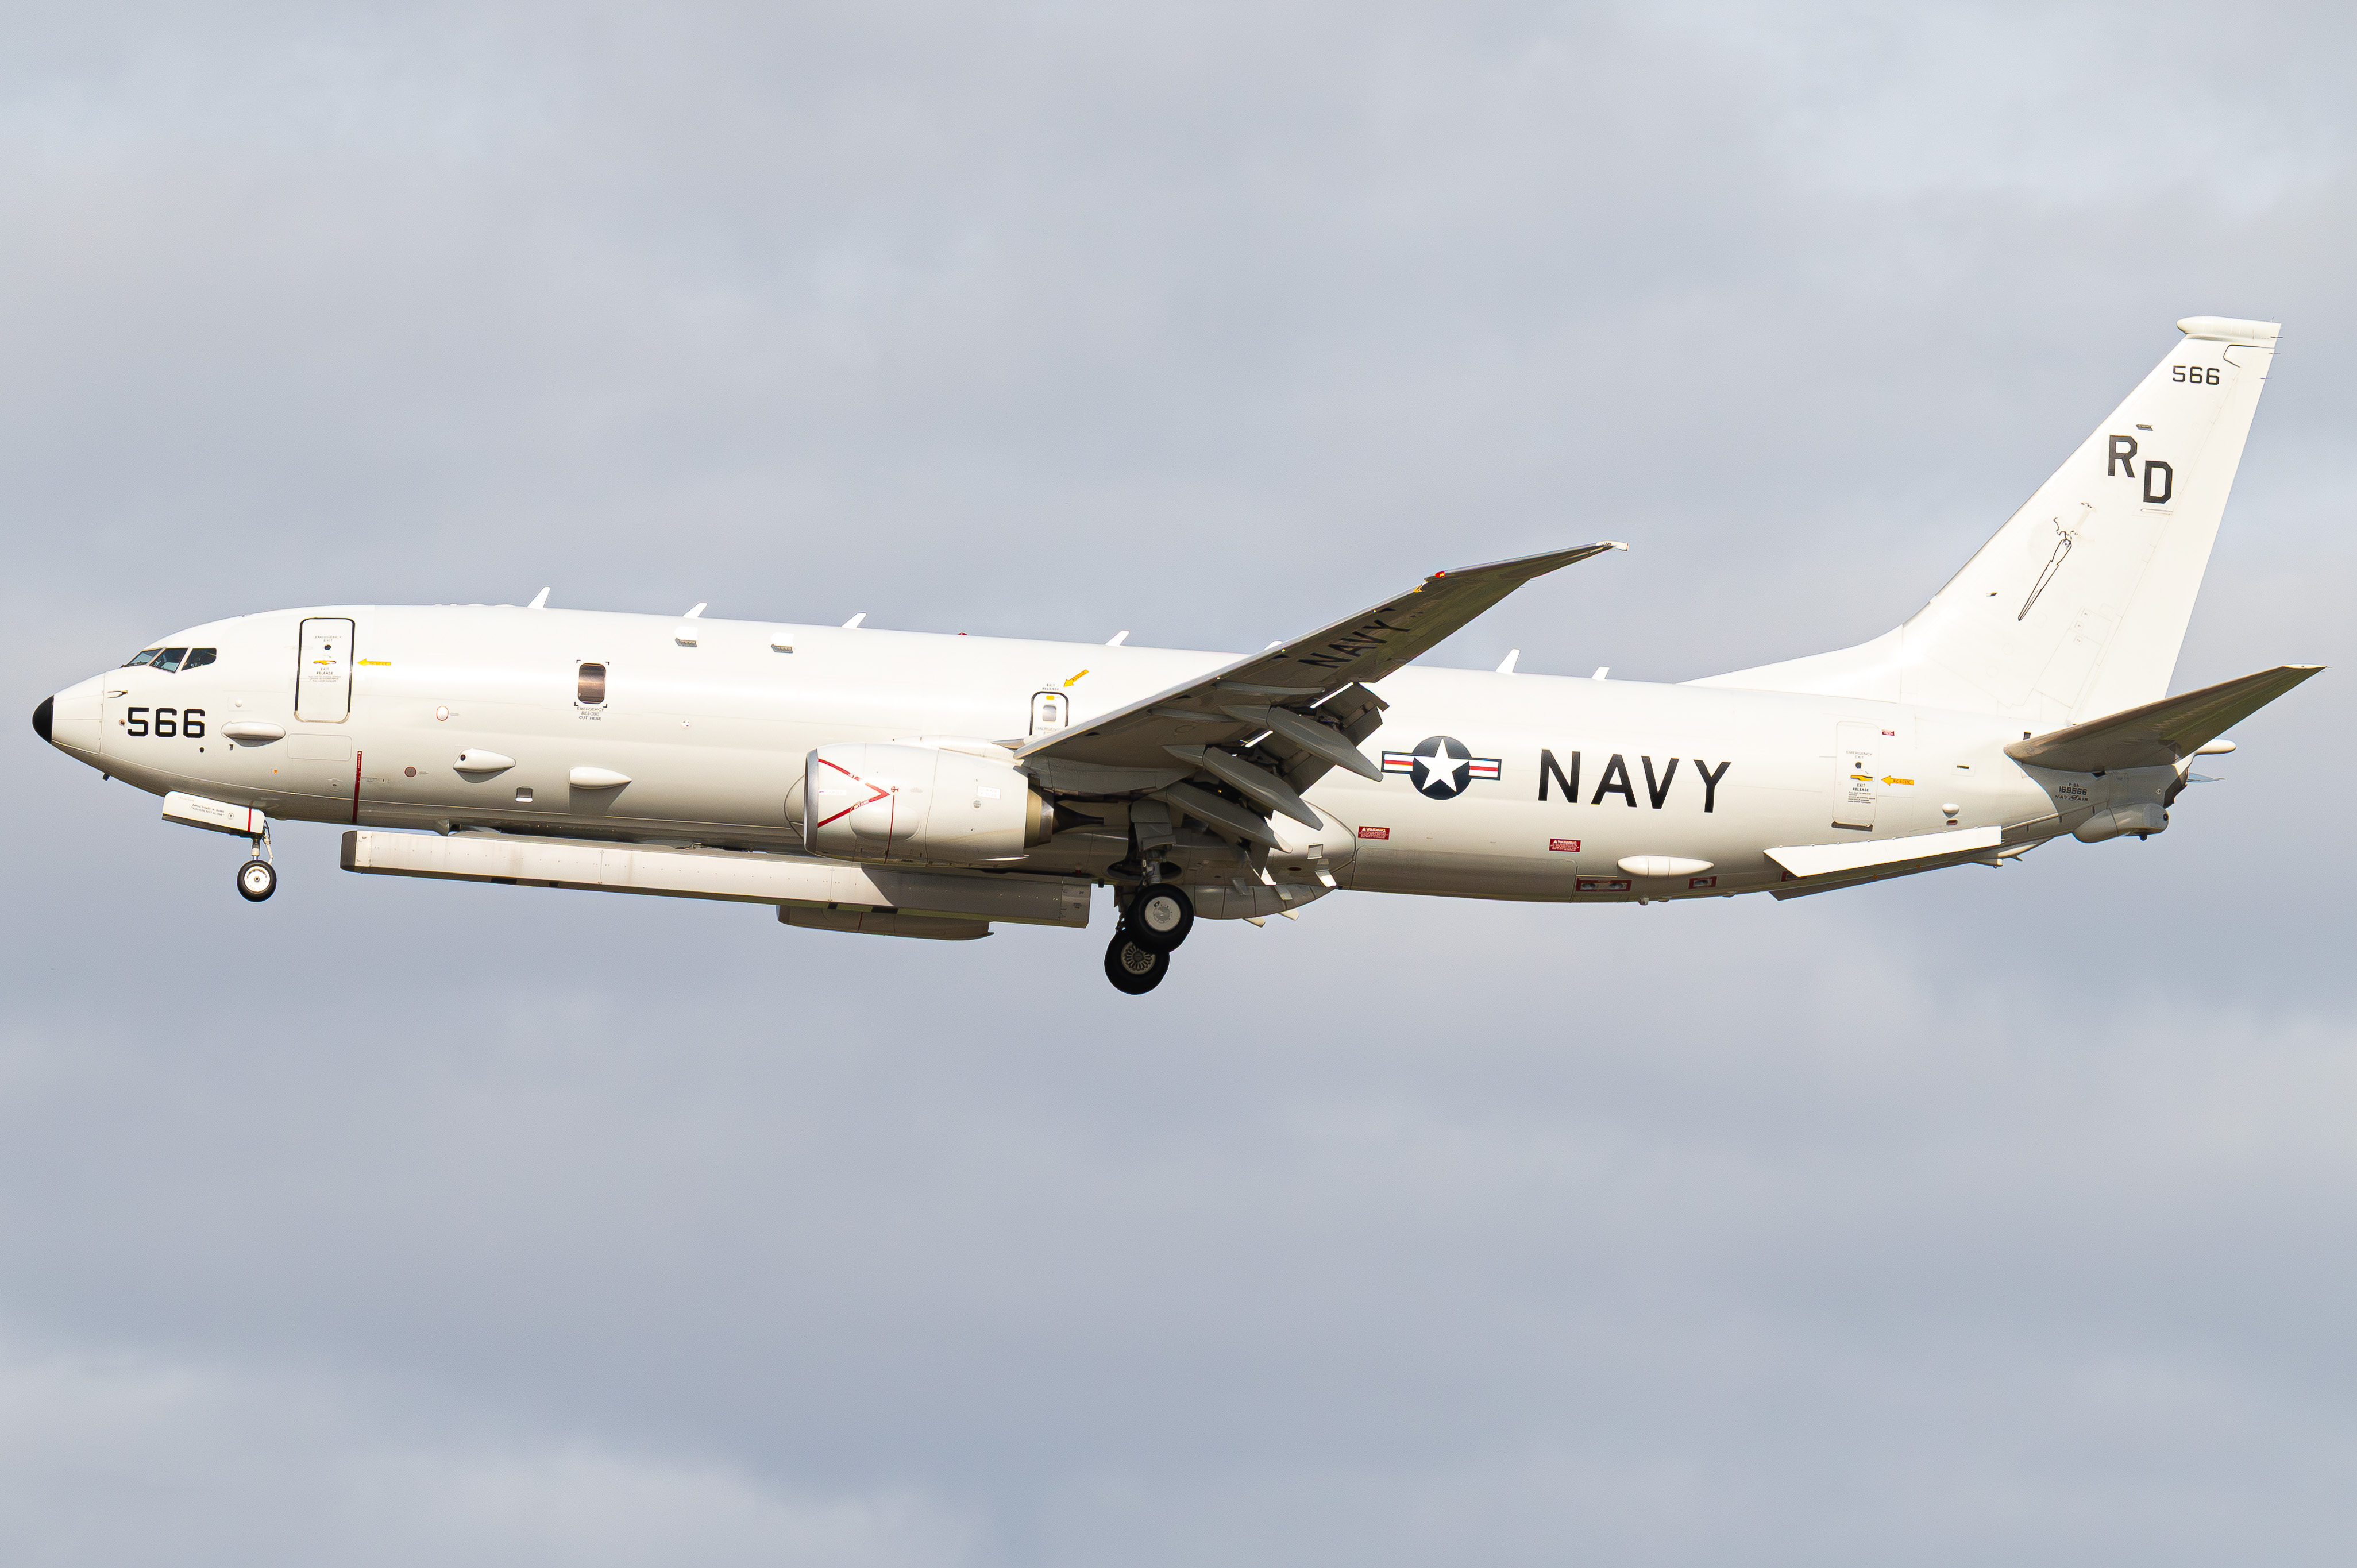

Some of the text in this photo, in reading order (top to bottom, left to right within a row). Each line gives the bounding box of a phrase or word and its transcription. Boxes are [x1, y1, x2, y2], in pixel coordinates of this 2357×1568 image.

[2172, 365, 2220, 385] 566
[1297, 619, 1411, 669] NAVY
[127, 706, 206, 739] 566
[1538, 748, 1731, 813] NAVY
[2058, 786, 2088, 795] 169566
